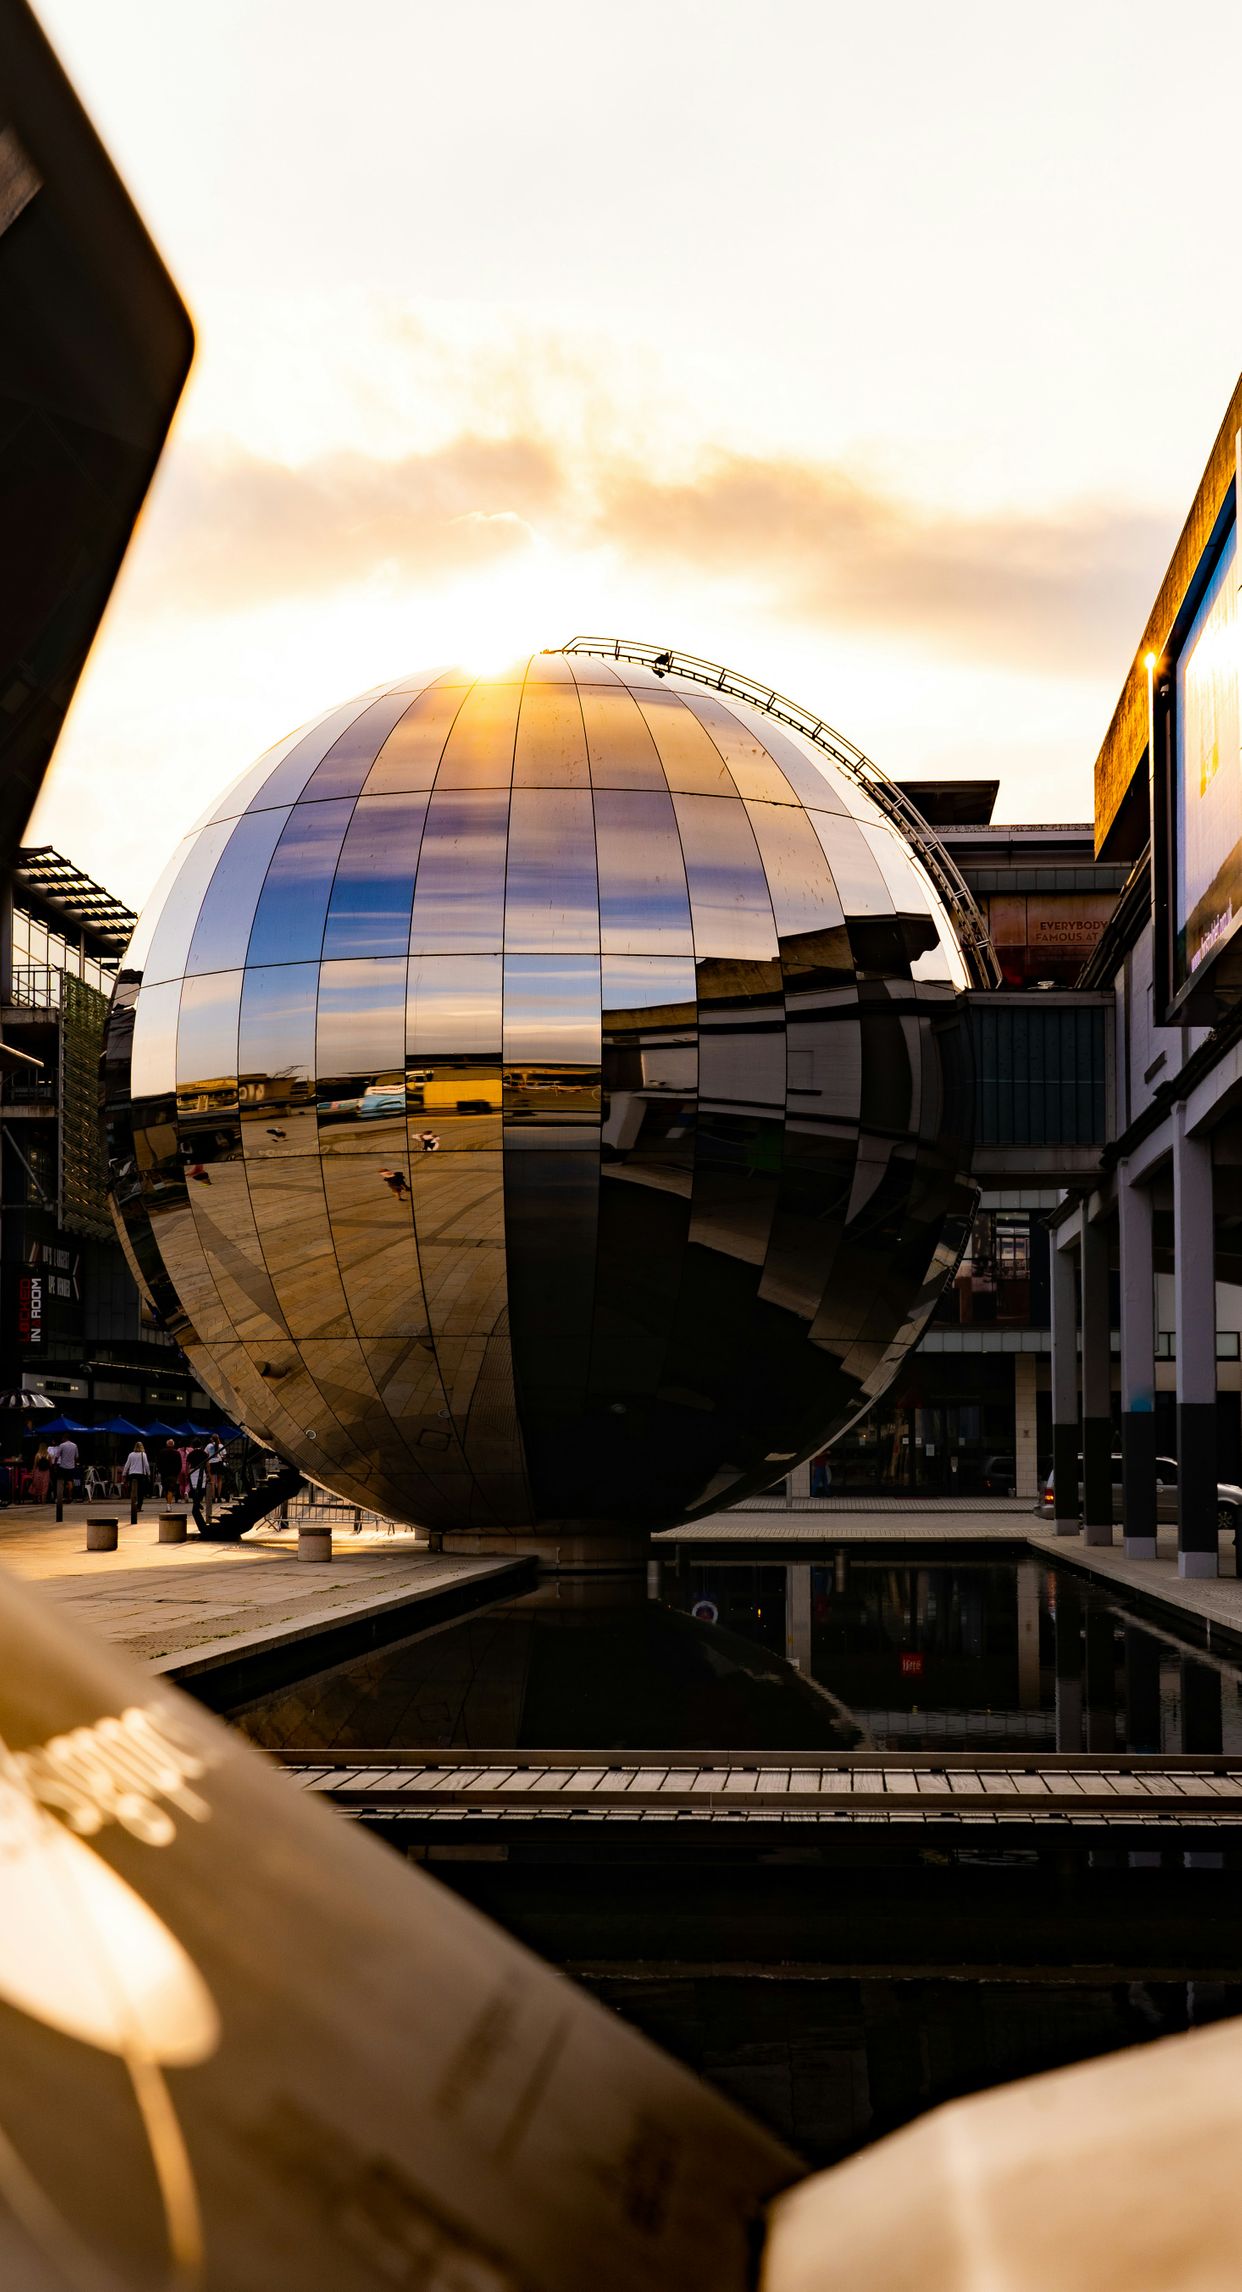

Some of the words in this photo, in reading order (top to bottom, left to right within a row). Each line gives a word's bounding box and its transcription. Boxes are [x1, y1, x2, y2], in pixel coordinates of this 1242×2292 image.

[1040, 921, 1108, 930] EVERYBODY
[1036, 932, 1082, 941] FAMOUS
[1086, 933, 1098, 941] AT
[31, 1278, 41, 1319] ROOM
[31, 1328, 41, 1342] IN
